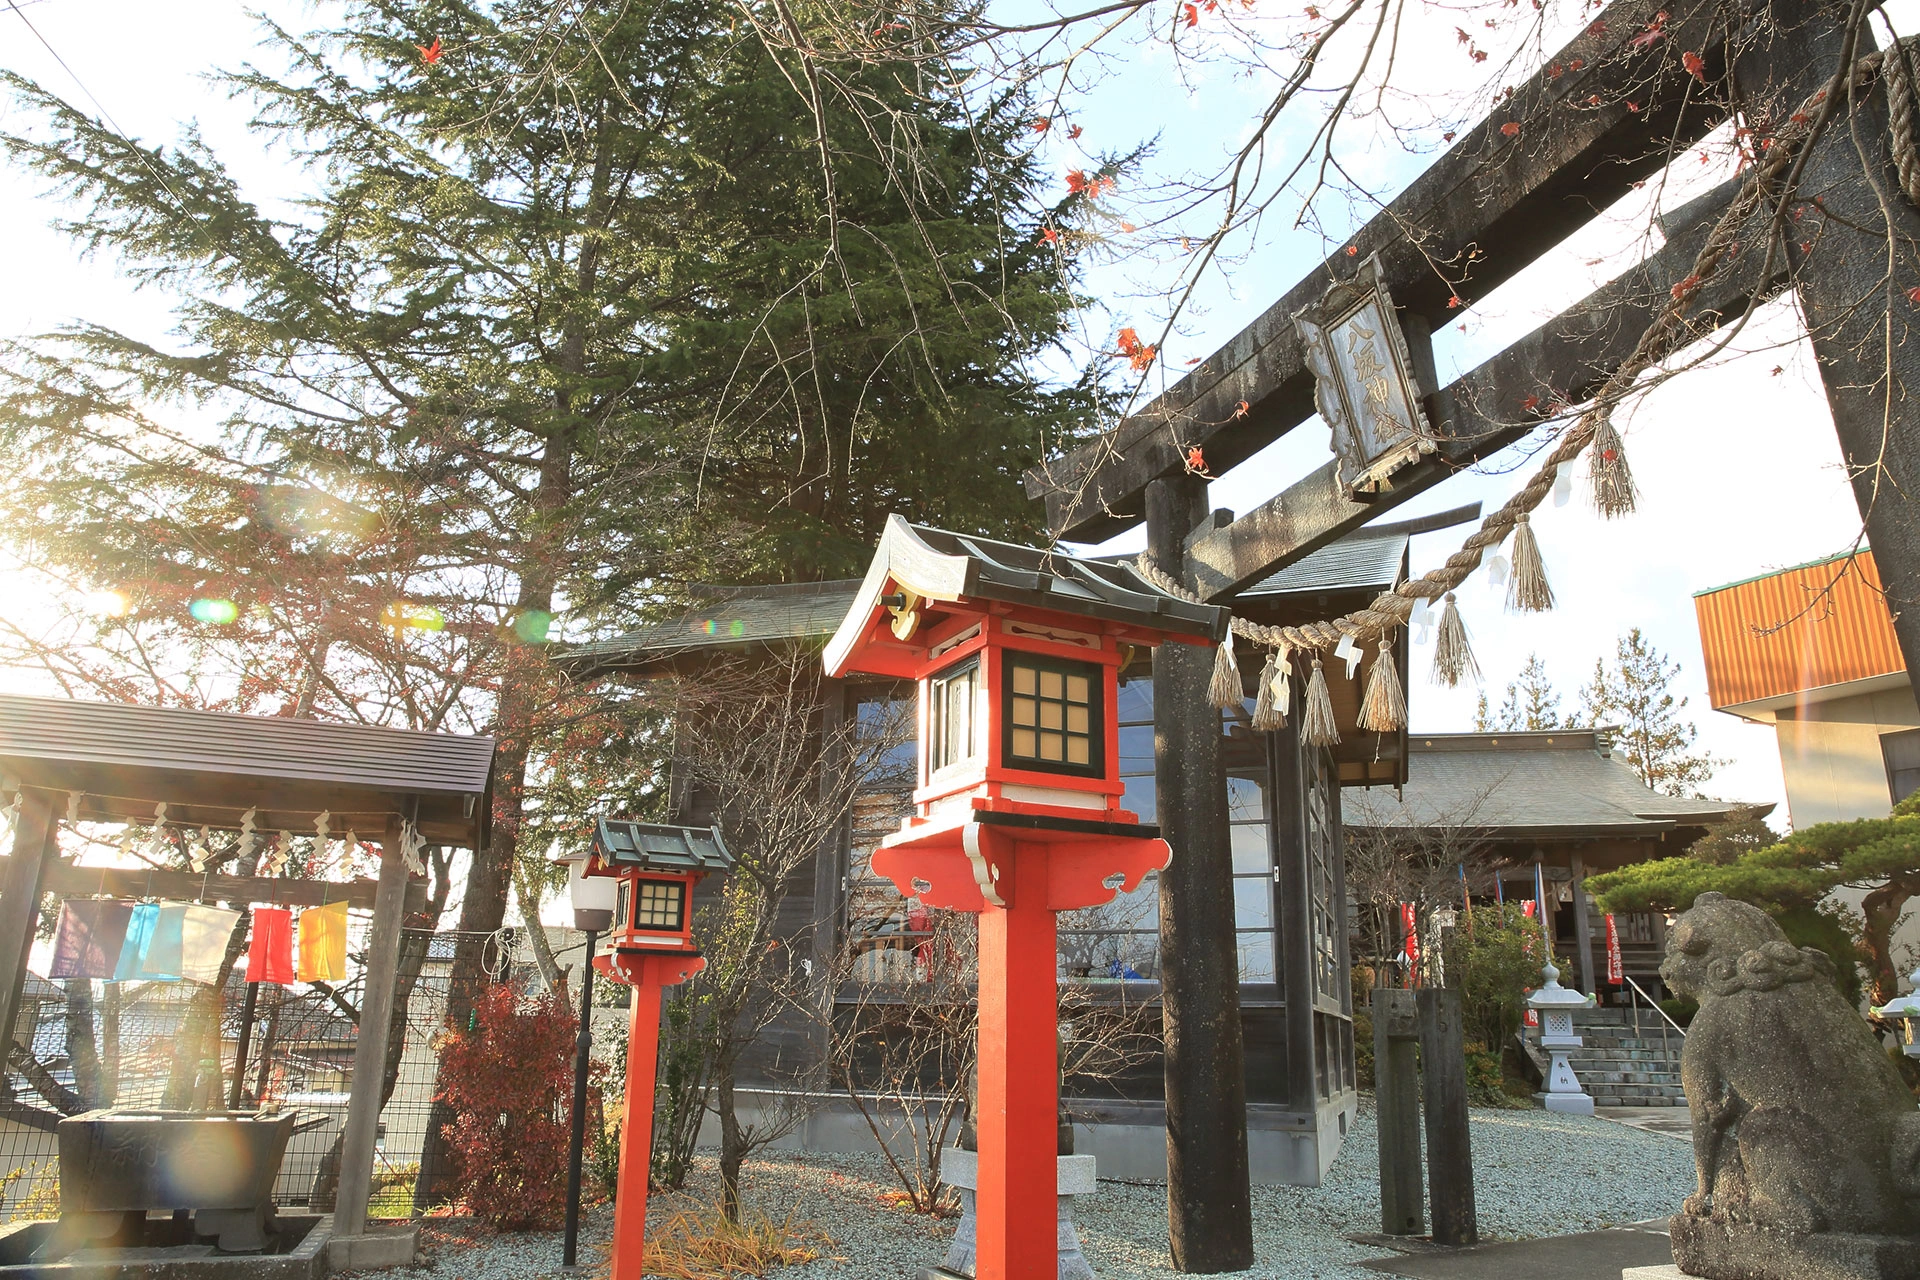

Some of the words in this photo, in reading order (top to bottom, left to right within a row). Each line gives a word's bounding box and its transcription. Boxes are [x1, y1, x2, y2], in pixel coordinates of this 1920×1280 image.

[1348, 321, 1401, 444] 八坂神社
[1558, 1062, 1569, 1084] 奉納
